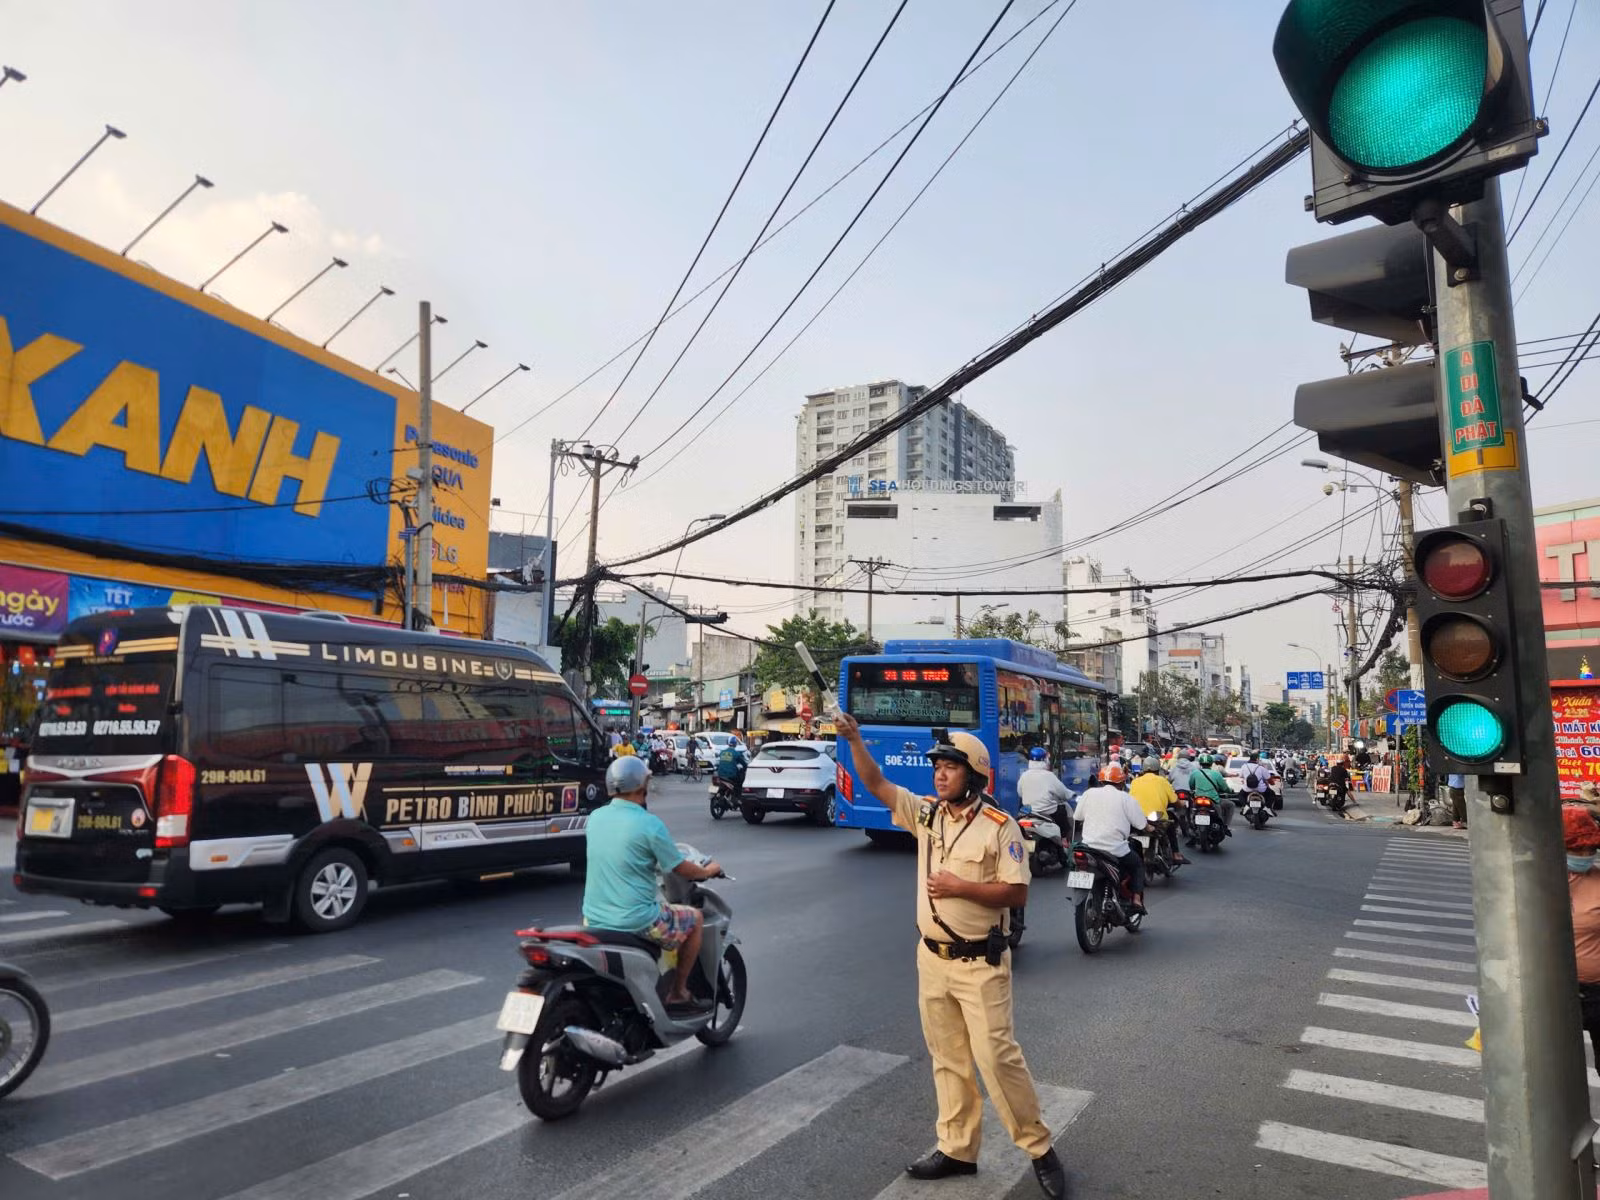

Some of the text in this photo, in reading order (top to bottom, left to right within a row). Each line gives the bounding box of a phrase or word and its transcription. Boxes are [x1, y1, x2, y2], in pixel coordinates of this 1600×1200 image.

[1461, 351, 1473, 367] A
[1455, 419, 1497, 445] PHẬT
[404, 424, 479, 469] Pasonic
[432, 464, 464, 490] QUA
[869, 479, 1025, 492] SEA HOLDINGS TOWER
[432, 506, 465, 530] idea
[104, 586, 134, 605] TẾT
[0, 612, 35, 627] ước
[321, 643, 483, 676] LIMOUSINE
[1562, 720, 1587, 734] MẮT
[884, 754, 933, 767] 50E-211.5
[201, 769, 267, 784] 29H-904.61
[385, 789, 554, 823] PETRO BÌNH PHƯỚC
